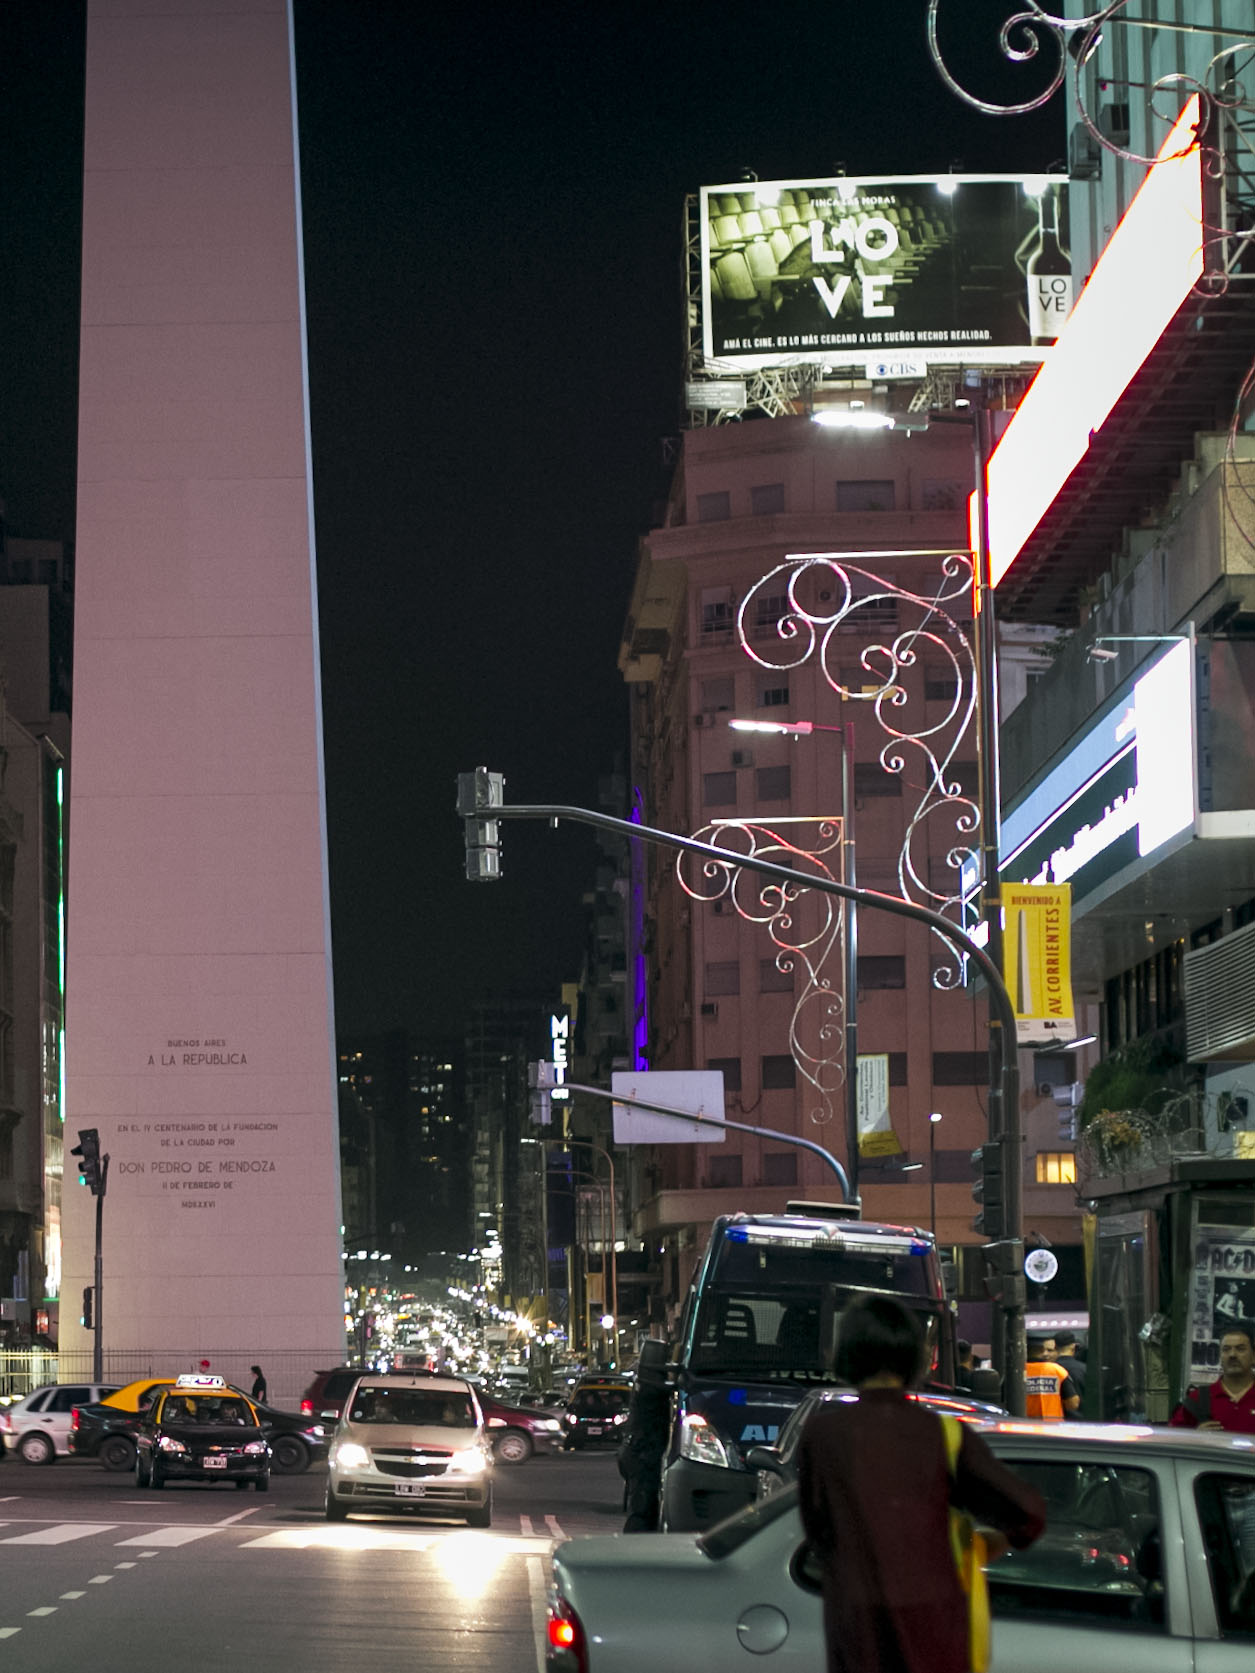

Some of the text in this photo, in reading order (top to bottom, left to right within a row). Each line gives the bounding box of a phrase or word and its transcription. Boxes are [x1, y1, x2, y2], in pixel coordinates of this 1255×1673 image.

[861, 195, 896, 205] MORAS
[1038, 278, 1067, 294] LO
[1038, 295, 1066, 312] VE
[723, 329, 993, 349] AMÁ EL CINE. ES LO MÁS CERCANO A LOS SUEÑOS HECHOS REALIDAD.
[890, 362, 917, 375] CBS
[1011, 895, 1062, 906] BIENVENIDO A
[1045, 908, 1063, 1015] AV. CORRIENTES
[167, 1039, 226, 1047] BUENOS AIRES
[147, 1053, 248, 1066] A LA REPUBLICA
[117, 1123, 278, 1132] EN EL IV CENTENARIO DE LA FUNDACION
[160, 1138, 235, 1147] DE LA CIUDAD POR
[119, 1160, 276, 1174] DON PEDRO DE MENDOZA
[170, 1181, 180, 1189] DE
[182, 1181, 220, 1189] FEBRERO
[223, 1181, 233, 1189] DE
